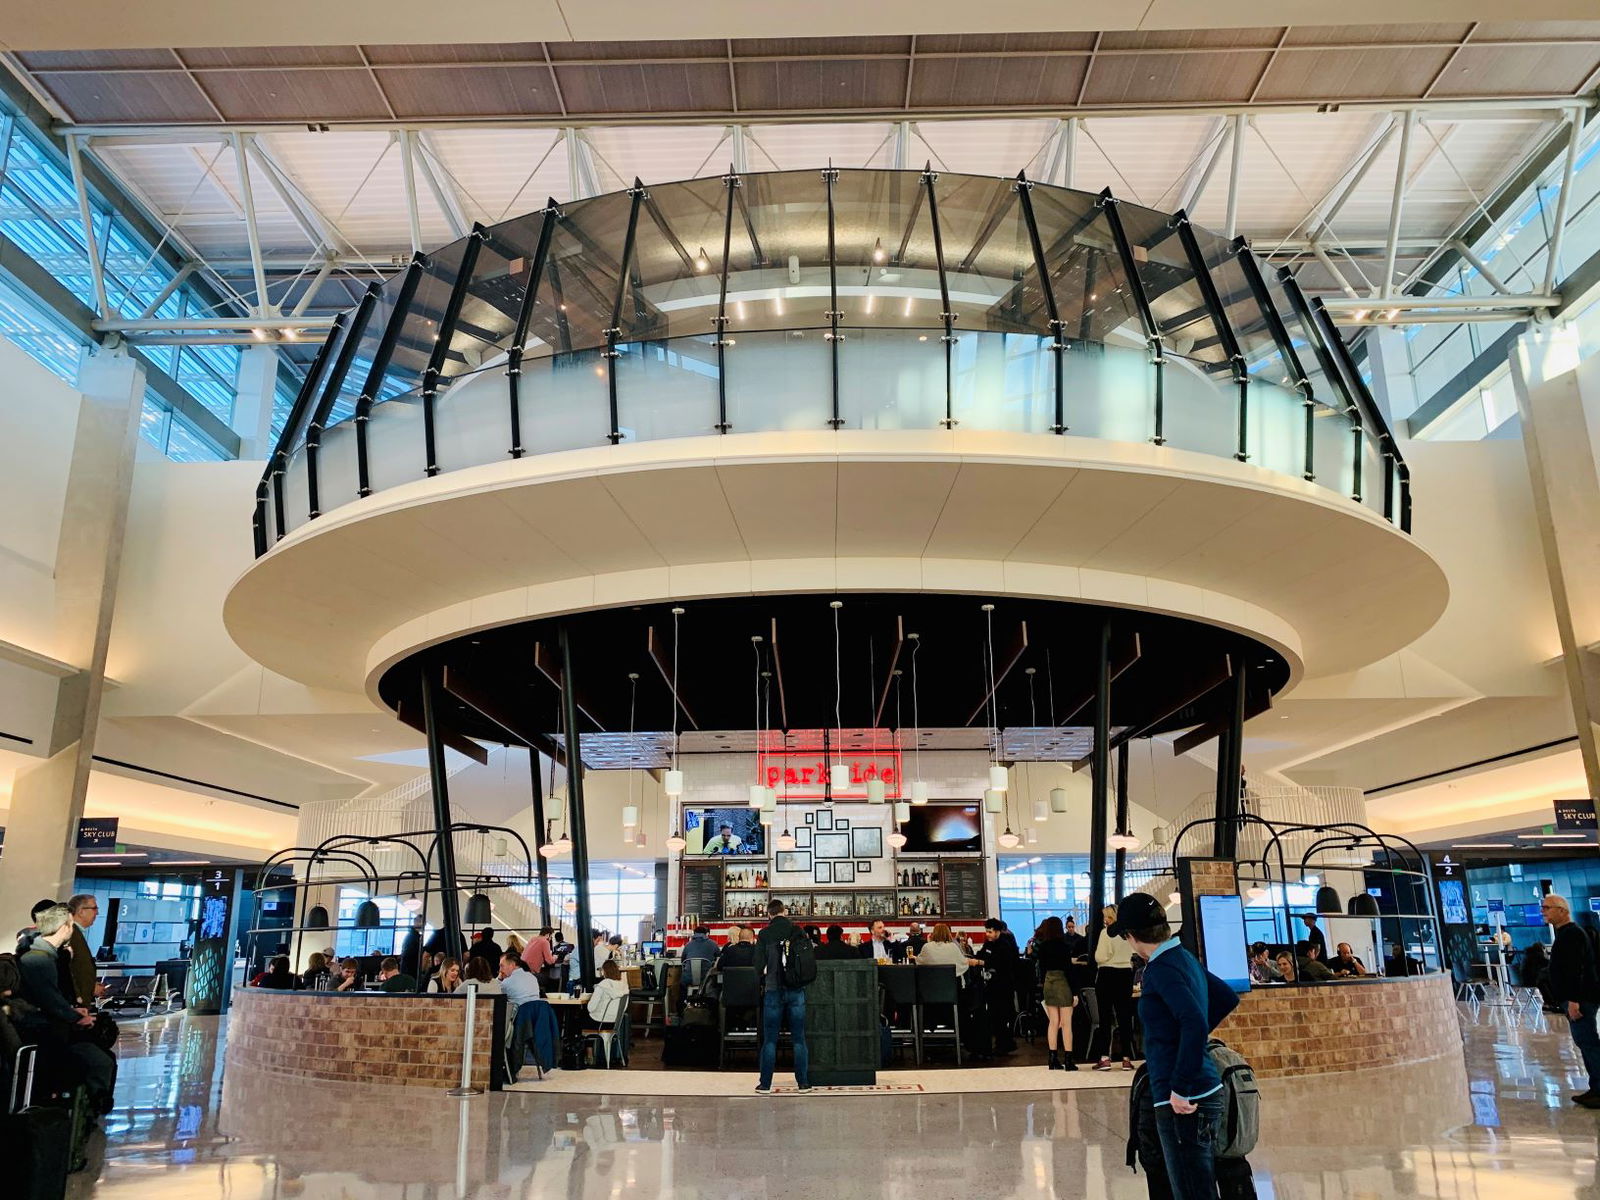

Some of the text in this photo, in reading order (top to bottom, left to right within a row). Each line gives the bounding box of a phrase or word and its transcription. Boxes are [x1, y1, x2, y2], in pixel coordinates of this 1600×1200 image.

[766, 762, 895, 788] parkide
[1443, 855, 1451, 863] 4
[215, 870, 222, 879] 3
[1445, 866, 1453, 875] 2
[215, 882, 220, 891] 1
[1475, 891, 1481, 901] 2
[1533, 886, 1539, 898] 4
[122, 905, 128, 916] 3
